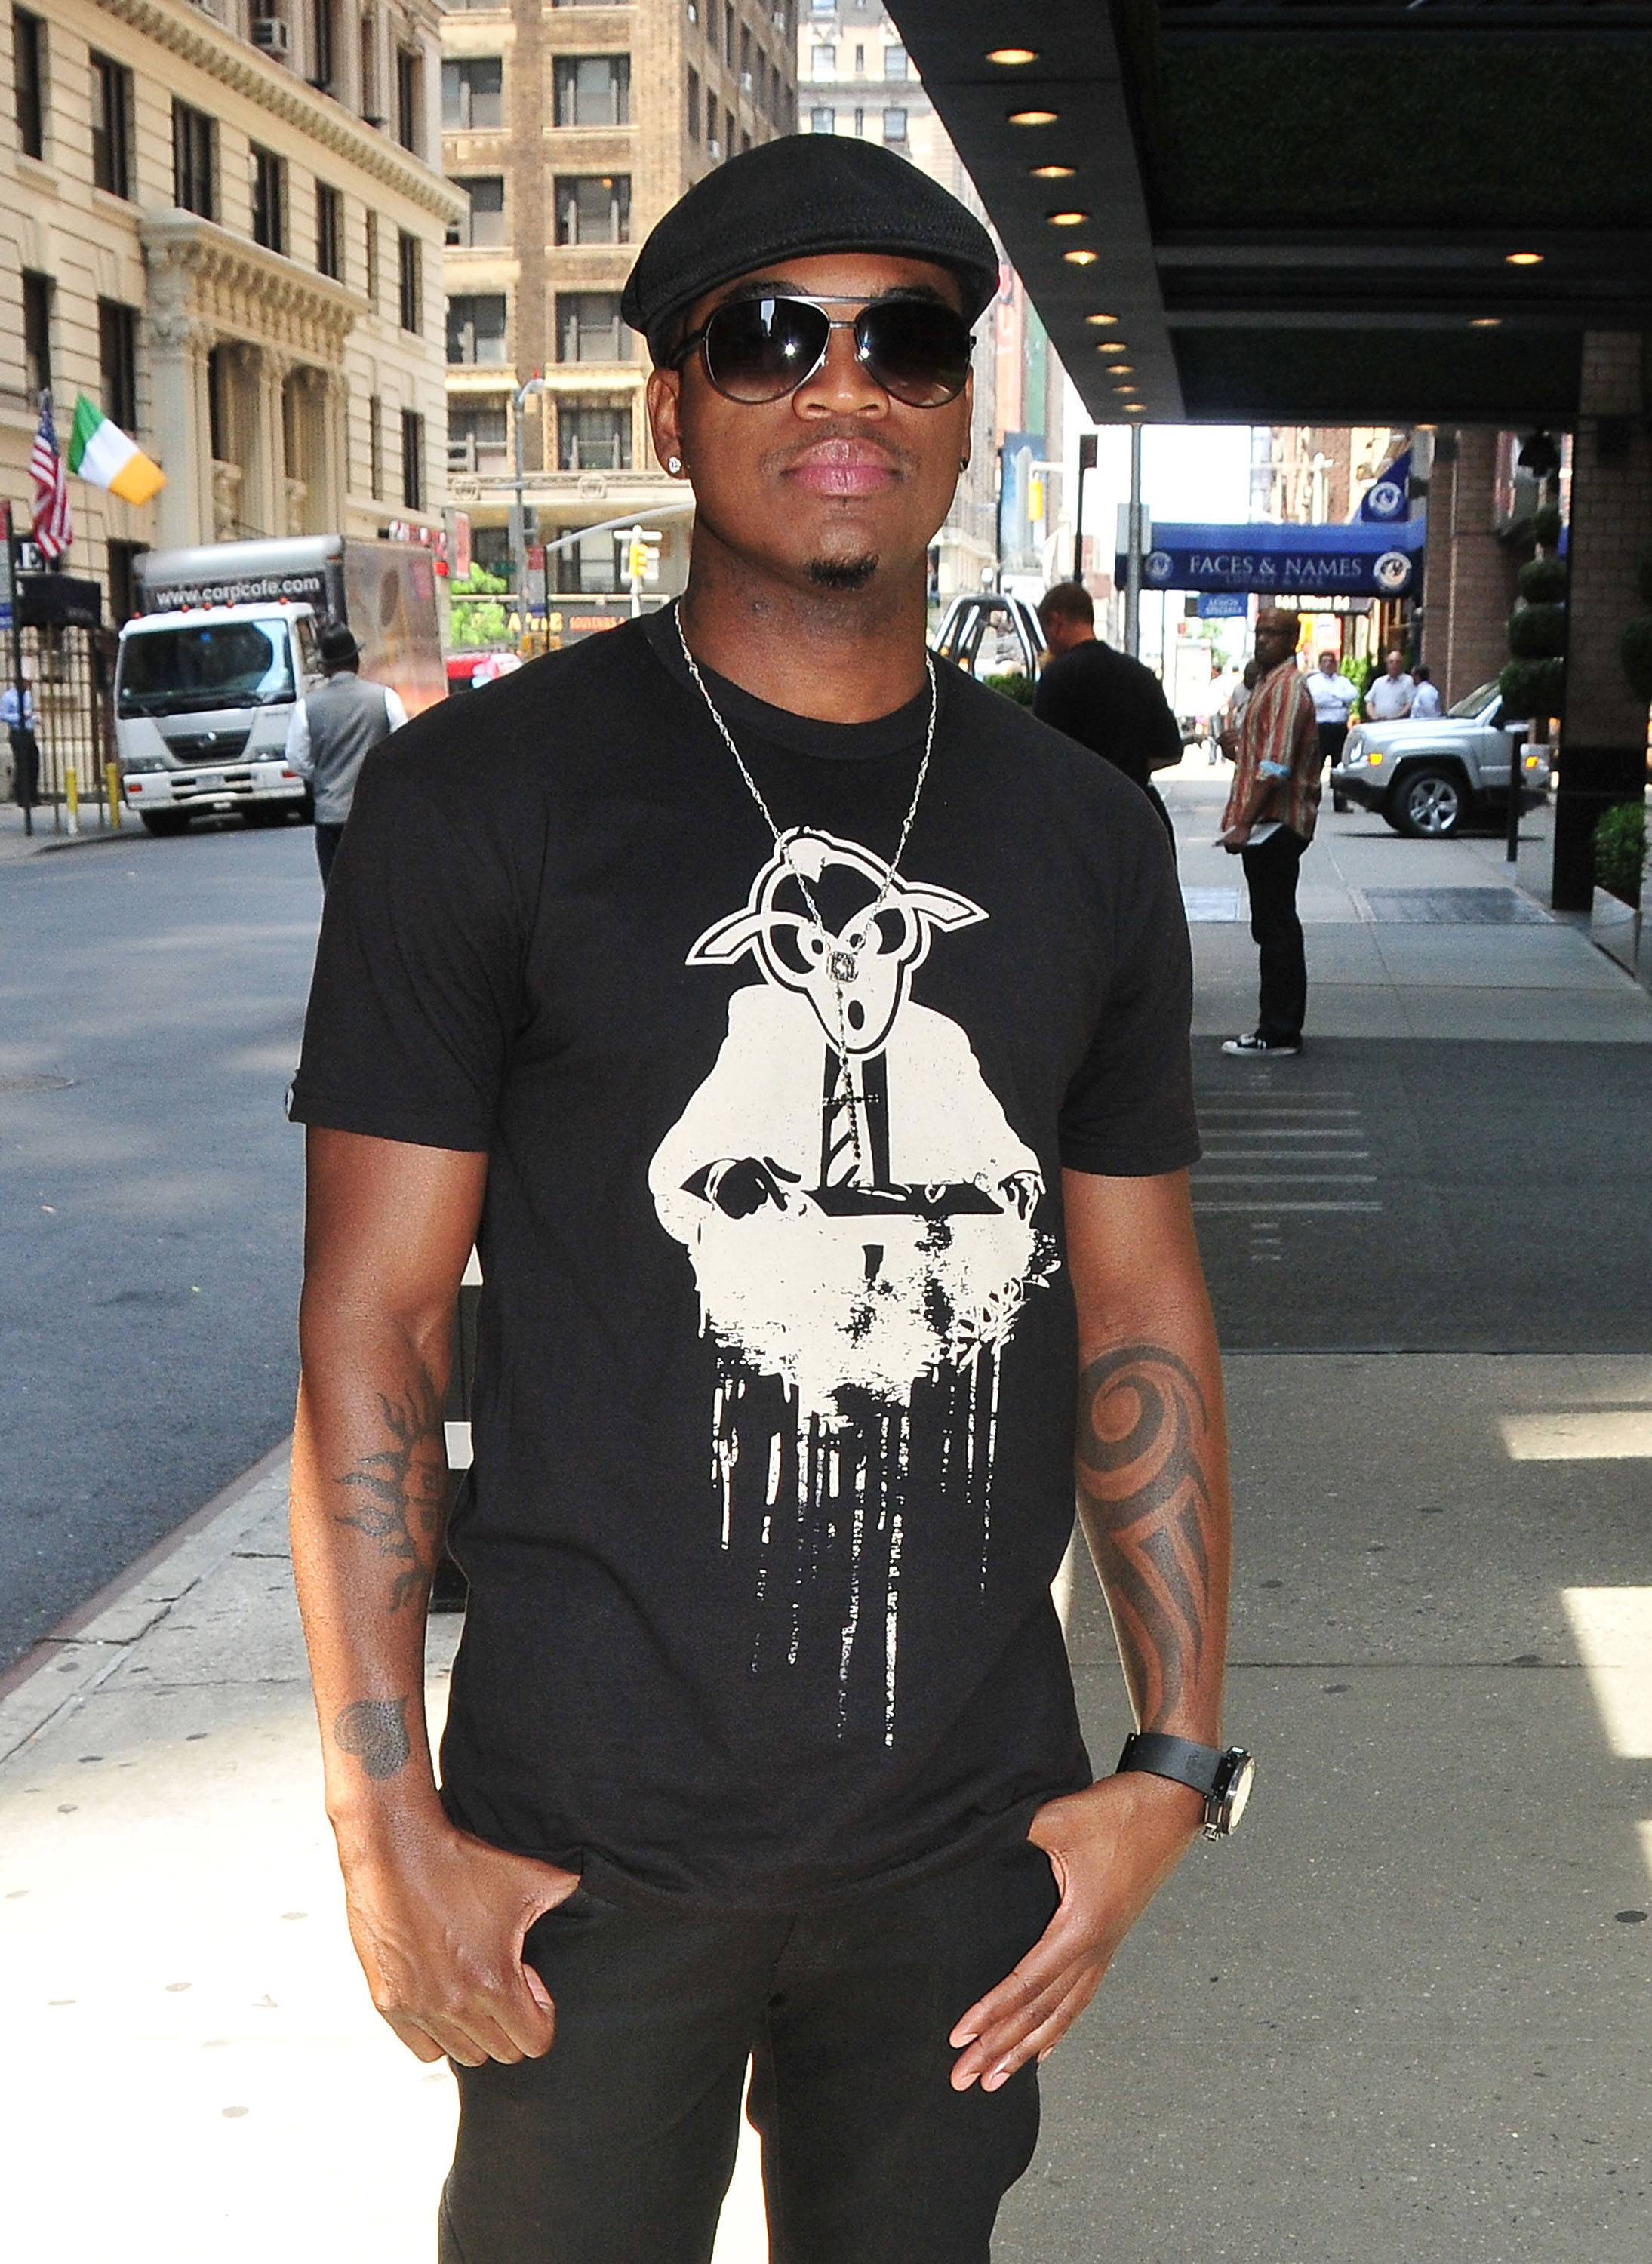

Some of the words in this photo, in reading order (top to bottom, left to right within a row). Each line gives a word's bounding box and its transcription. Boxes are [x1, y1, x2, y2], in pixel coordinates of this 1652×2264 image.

[1189, 555, 1253, 574] FACES
[1259, 557, 1275, 575] &
[1284, 558, 1362, 576] NAMES
